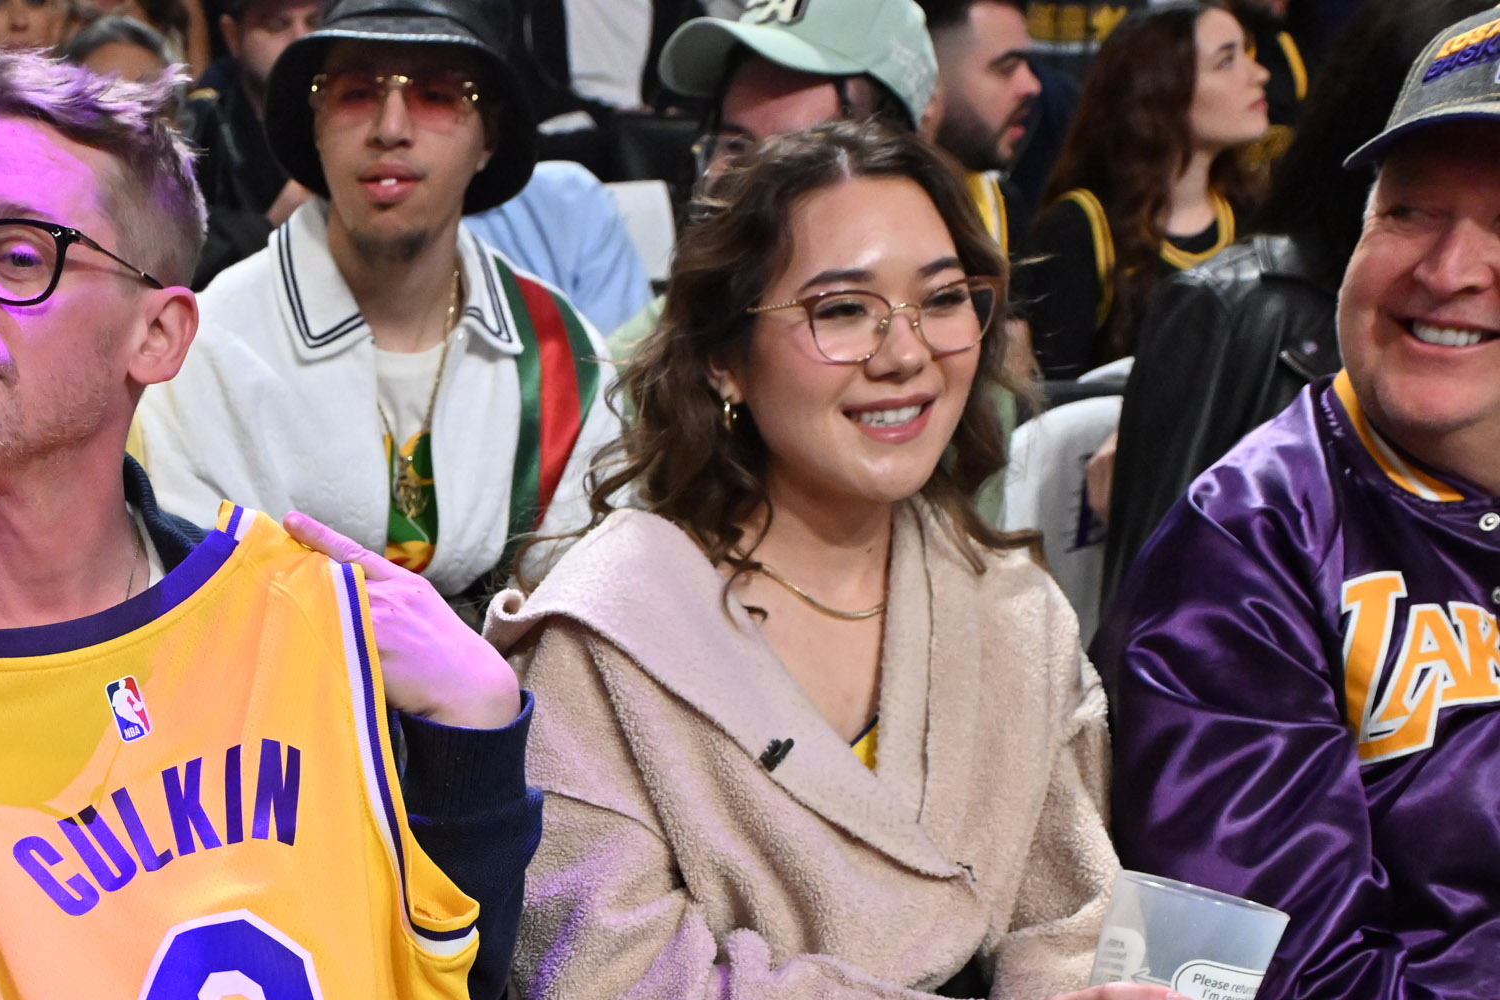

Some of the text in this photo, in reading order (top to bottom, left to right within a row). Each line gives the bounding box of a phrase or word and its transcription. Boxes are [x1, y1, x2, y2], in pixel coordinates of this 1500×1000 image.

[124, 725, 141, 739] NBA
[13, 738, 300, 916] CULKIN
[1192, 973, 1230, 990] Please
[1201, 988, 1220, 1000] I'm
